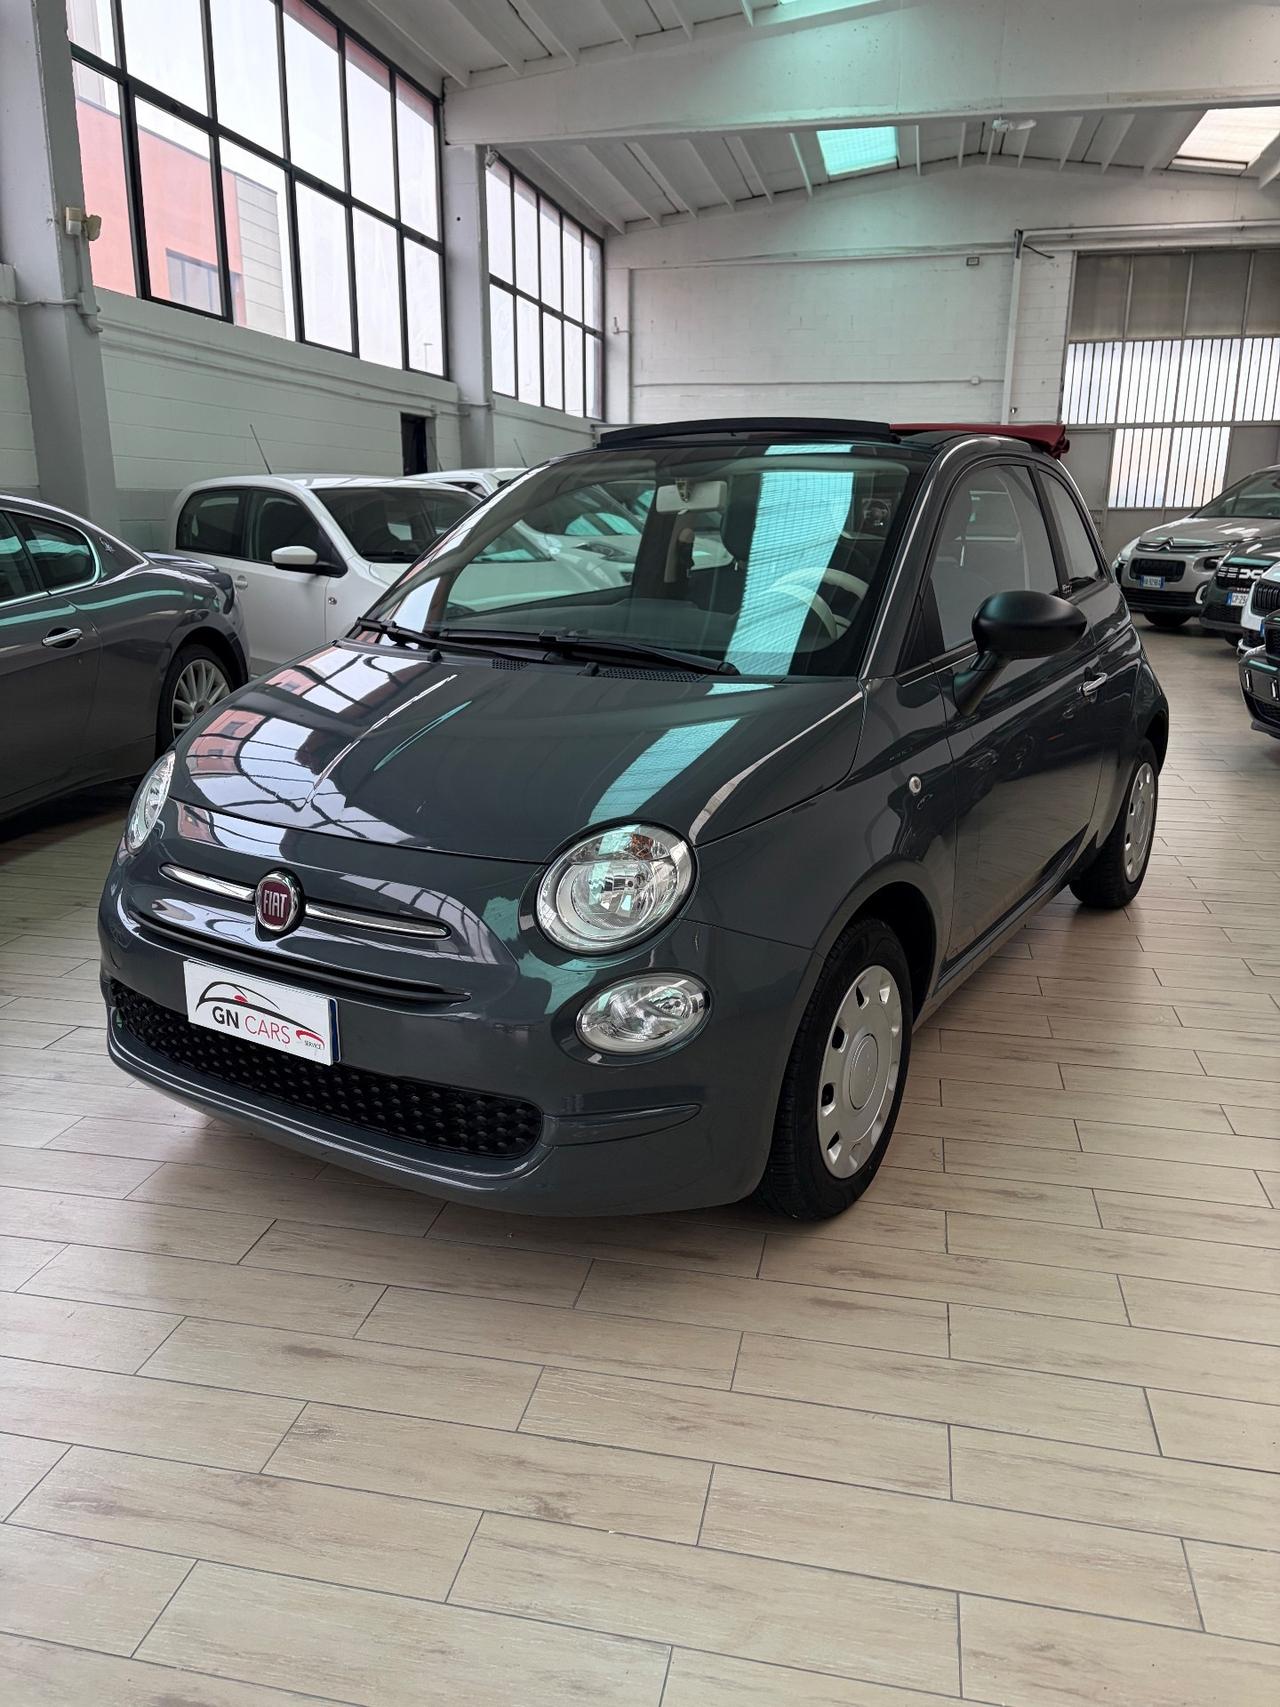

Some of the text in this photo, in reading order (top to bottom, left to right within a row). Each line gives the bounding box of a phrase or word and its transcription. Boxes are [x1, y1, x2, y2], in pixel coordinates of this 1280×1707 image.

[263, 889, 288, 918] FIAT
[212, 1006, 291, 1045] GN CARS
